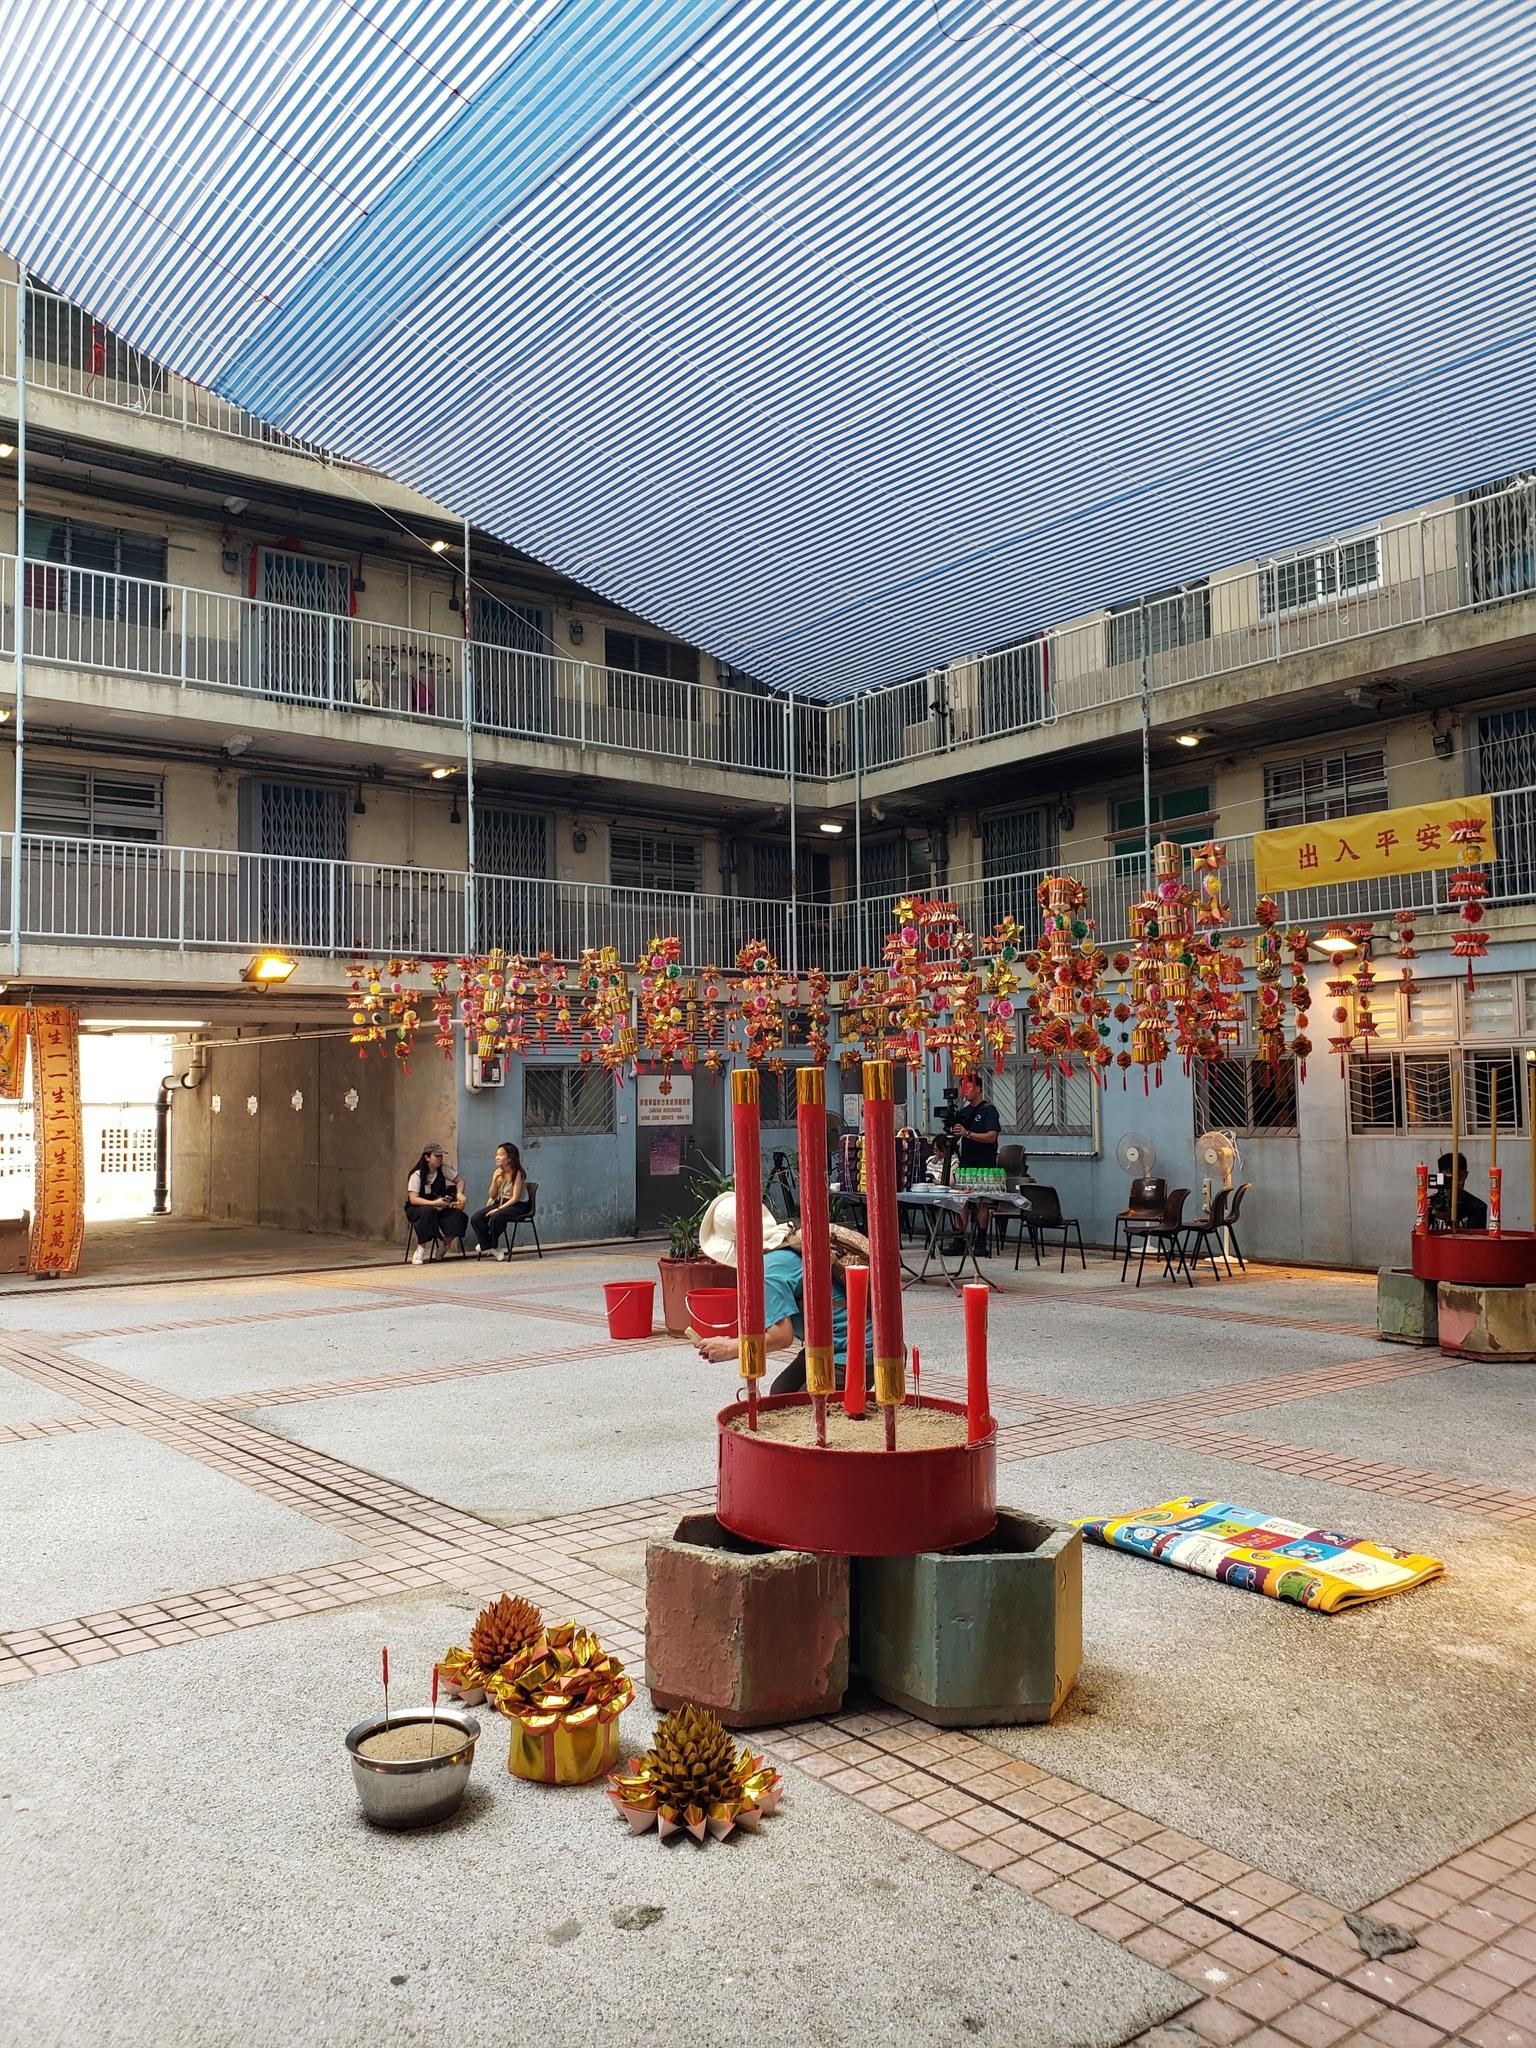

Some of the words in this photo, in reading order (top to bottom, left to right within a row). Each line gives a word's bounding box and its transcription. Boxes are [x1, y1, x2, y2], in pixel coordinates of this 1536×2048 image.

[1298, 823, 1441, 870] 出入平安
[43, 1011, 70, 1268] 道生一一生二二生三三生萬物
